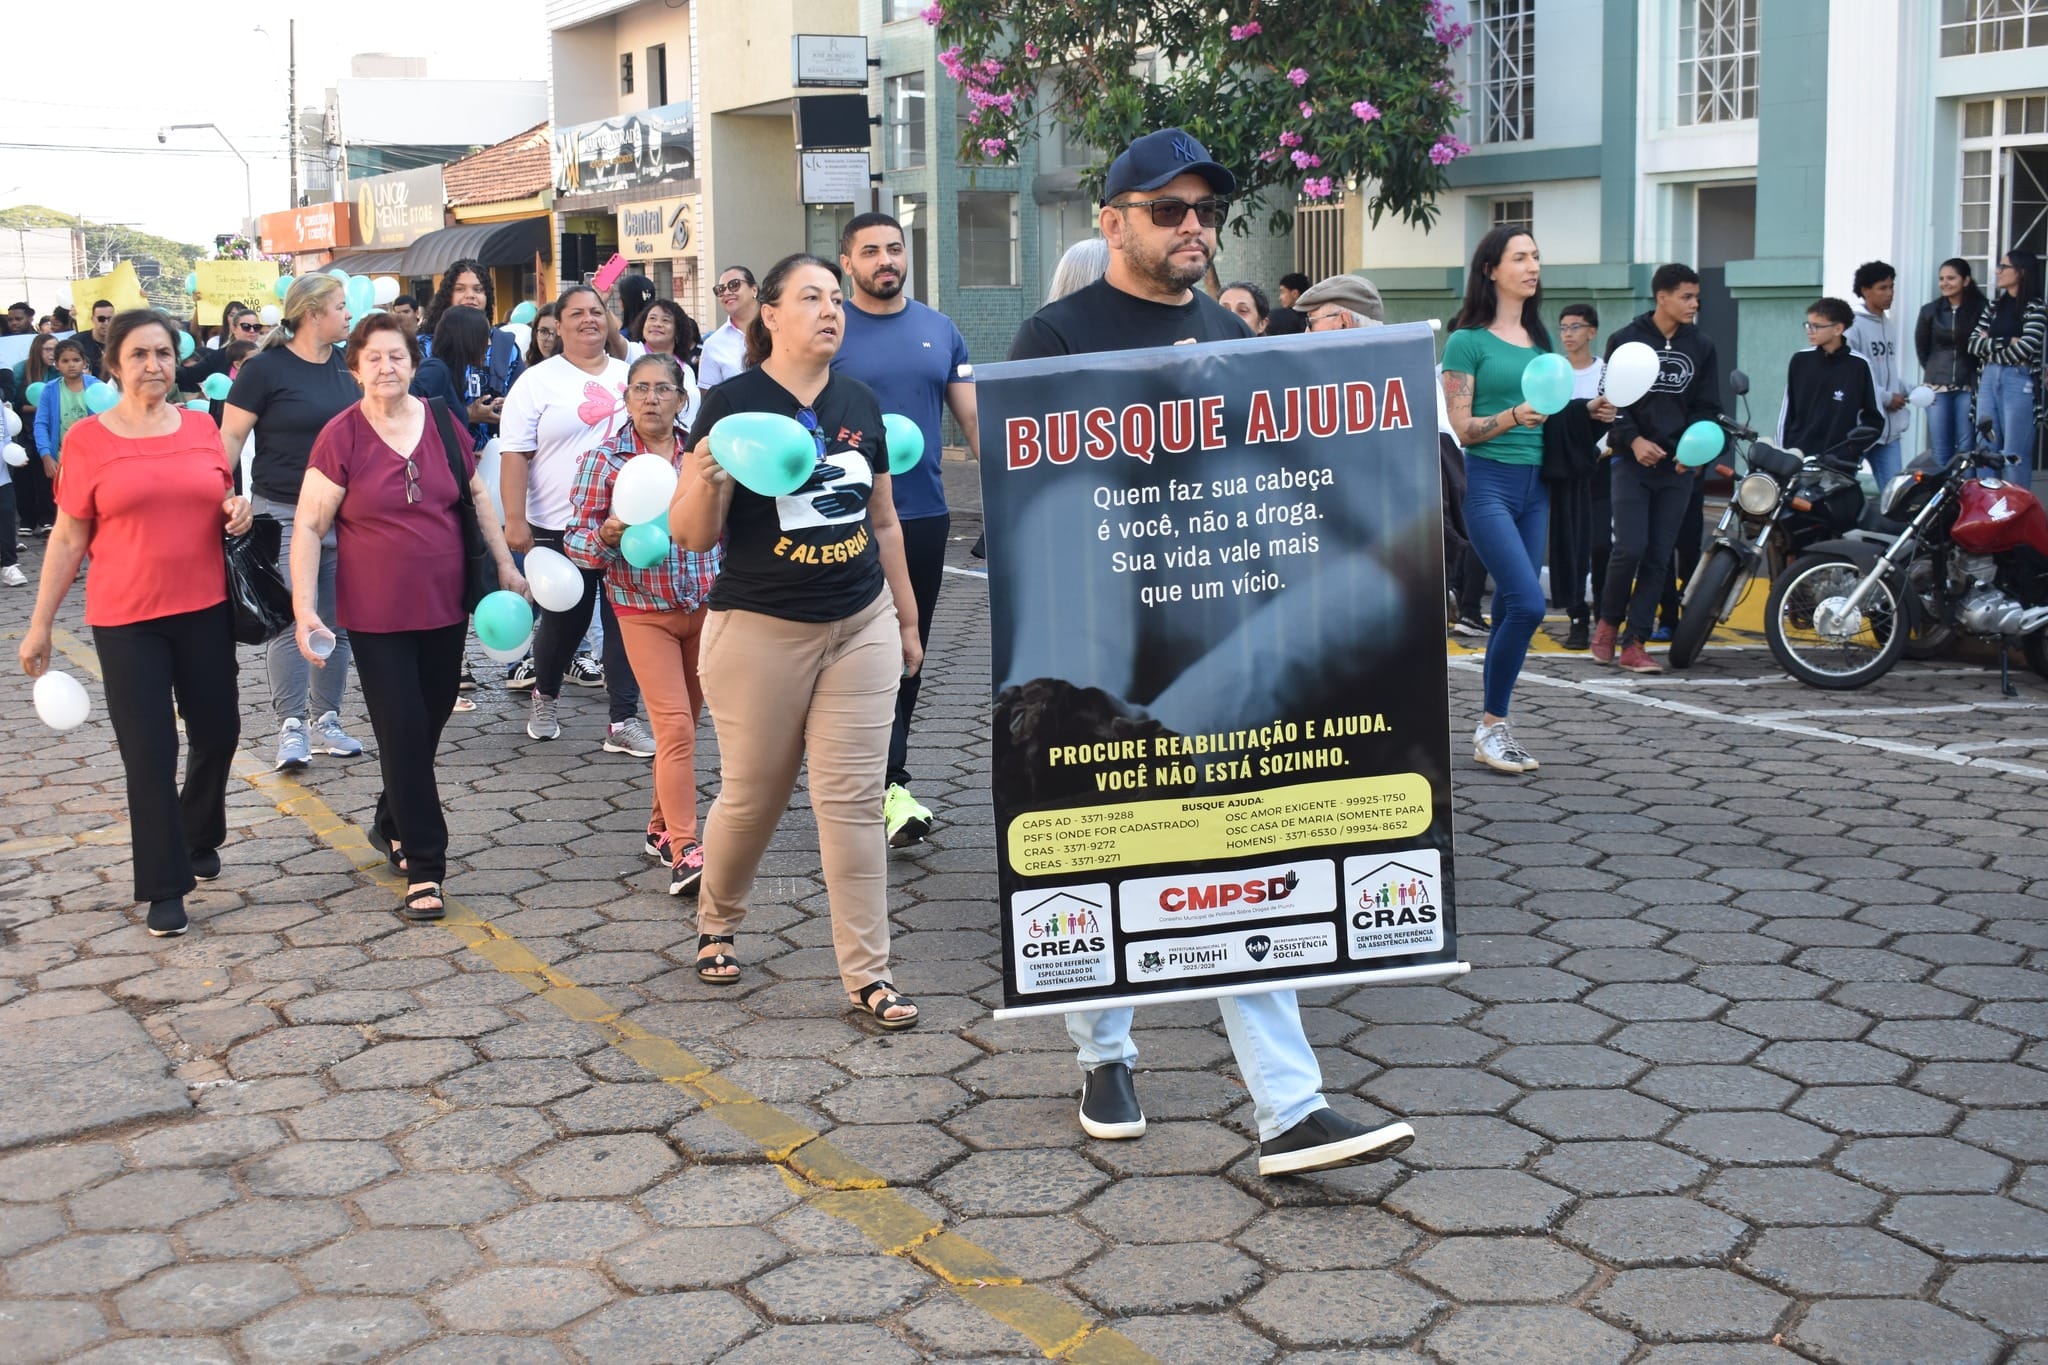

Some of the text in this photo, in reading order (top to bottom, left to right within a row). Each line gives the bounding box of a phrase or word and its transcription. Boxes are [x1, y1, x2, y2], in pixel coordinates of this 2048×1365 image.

[376, 204, 433, 230] MENTE STORE
[624, 206, 664, 237] Central
[243, 297, 260, 306] NÃO
[1005, 377, 1412, 470] BUSQUE AJUDA
[837, 426, 863, 448] FÉ
[1094, 466, 1334, 510] Quem faz sua cabeça
[1098, 501, 1324, 541] é você, não a droga.
[773, 524, 869, 565] E ALEGRIA!
[1112, 533, 1320, 573] Sua vida vale mais
[1140, 569, 1287, 608] que um vício.
[1049, 712, 1392, 767] PROCURE REABILITAÇÃO E AJUDA.
[1095, 746, 1350, 792] VOCÊ NÃO ESTÁ SOZINHO.
[1182, 796, 1264, 812] BUSQUE AJUDA:
[1225, 812, 1248, 822] OSC
[1250, 807, 1282, 818] AMOR
[1285, 800, 1337, 814] EXIGENTE
[1346, 792, 1406, 806] 99925-1750
[1023, 819, 1053, 830] CAPS
[1055, 817, 1072, 827] AD
[1081, 811, 1134, 824] 3371-9288
[1023, 819, 1200, 844] PSF'S (ONDE FOR CADASTRADO)
[1225, 805, 1425, 836] OSC CASA DE MARIA (SOMENTE PARA
[1226, 835, 1276, 849] HOMENS)
[1285, 828, 1337, 841] 3371-6530
[1346, 820, 1408, 834] 99934-8652
[1024, 847, 1054, 857] CRAS
[1064, 840, 1116, 854] 3371-9272
[1025, 860, 1062, 871] CREAS
[1071, 853, 1121, 867] 3371-9271
[1159, 876, 1293, 913] CMPSD
[1184, 913, 1207, 921] Municipal
[1352, 904, 1437, 930] CRAS
[1273, 939, 1328, 952] ASSISTÊNCIA
[1356, 934, 1382, 942] CENTRO
[1394, 928, 1434, 939] REFERÊNCIA
[1368, 938, 1409, 948] ASSISTÊNCIA
[1022, 937, 1106, 958] CREAS
[1169, 948, 1228, 965] PIUMHI
[1273, 951, 1304, 959] SOCIAL
[1030, 962, 1054, 970] CENTRO
[1064, 957, 1101, 967] REFERÊNCIA
[1038, 968, 1084, 978] ESPECIALIZADO
[1183, 962, 1215, 971] 2025/2028
[1036, 975, 1097, 987] ASSISTÊNCIA SOCIAL
